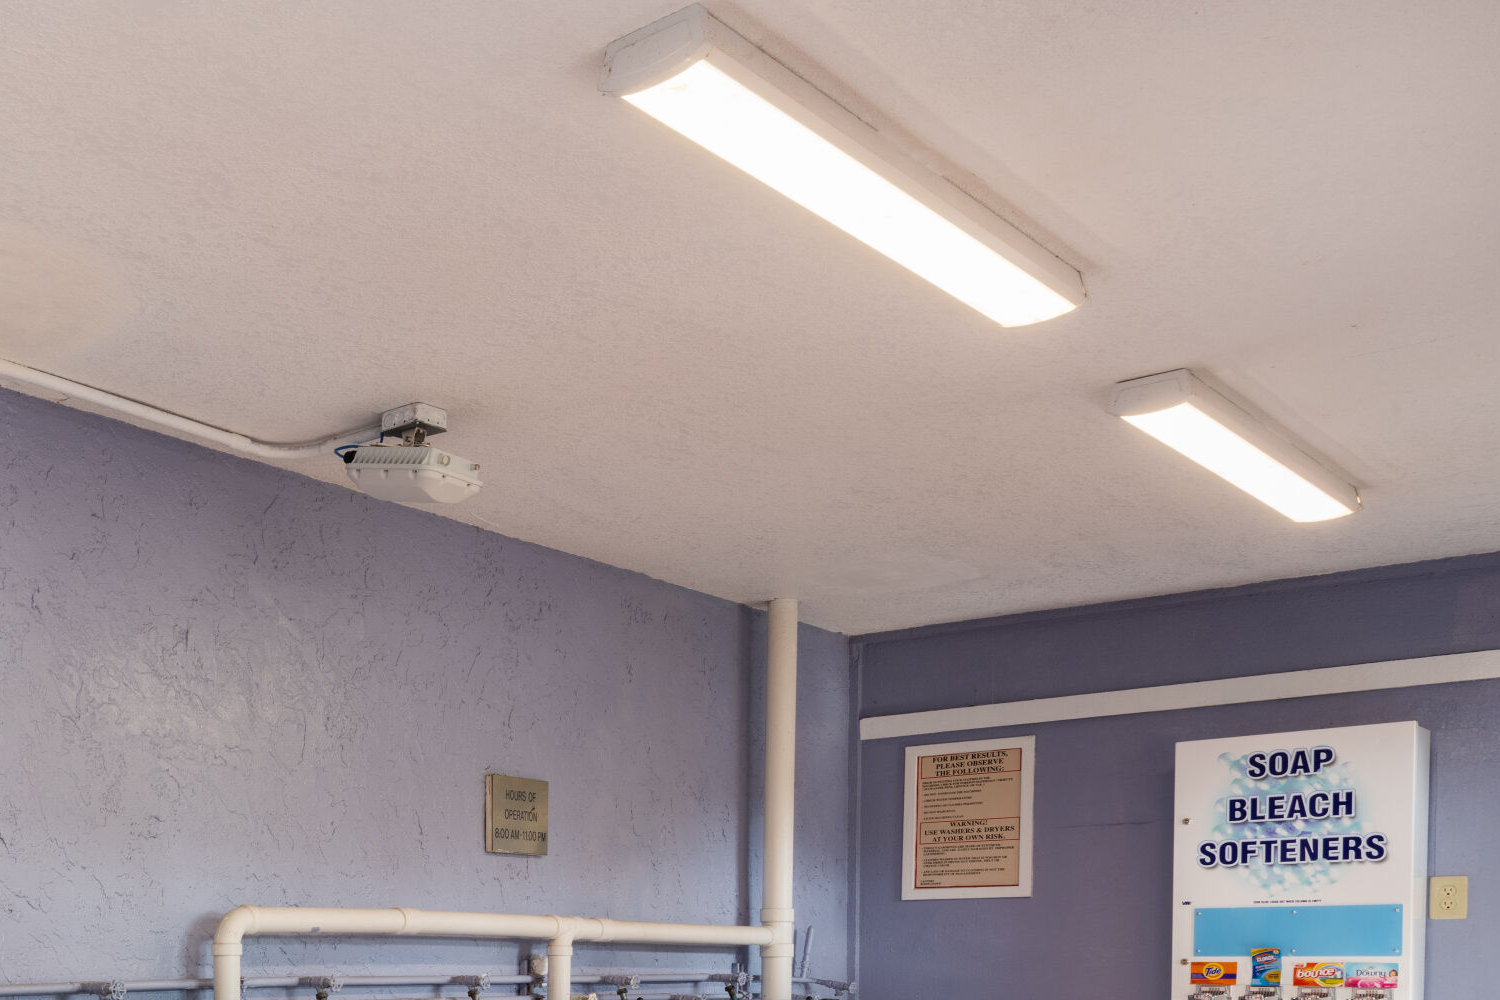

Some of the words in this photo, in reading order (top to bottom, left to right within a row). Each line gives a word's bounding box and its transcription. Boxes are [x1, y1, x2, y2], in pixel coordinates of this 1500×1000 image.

[932, 756, 948, 764] FOR
[950, 753, 969, 761] BEST
[971, 750, 1008, 760] RESULTS,
[936, 761, 965, 770] PLEASE
[967, 757, 1004, 767] OBSERVE
[1247, 747, 1334, 778] SOAP
[952, 765, 1005, 775] FOLLOWING:
[505, 789, 527, 801] HOURS
[528, 792, 537, 802] OF
[1228, 790, 1354, 823] BLEACH
[504, 809, 538, 822] OPERATION
[510, 829, 520, 839] AM
[538, 832, 547, 842] PM
[940, 827, 975, 835] WASHERS
[1199, 833, 1386, 867] SOFTENERS
[1205, 966, 1222, 977] Tide
[1297, 967, 1336, 978] bounce
[1356, 969, 1387, 978] Downy
